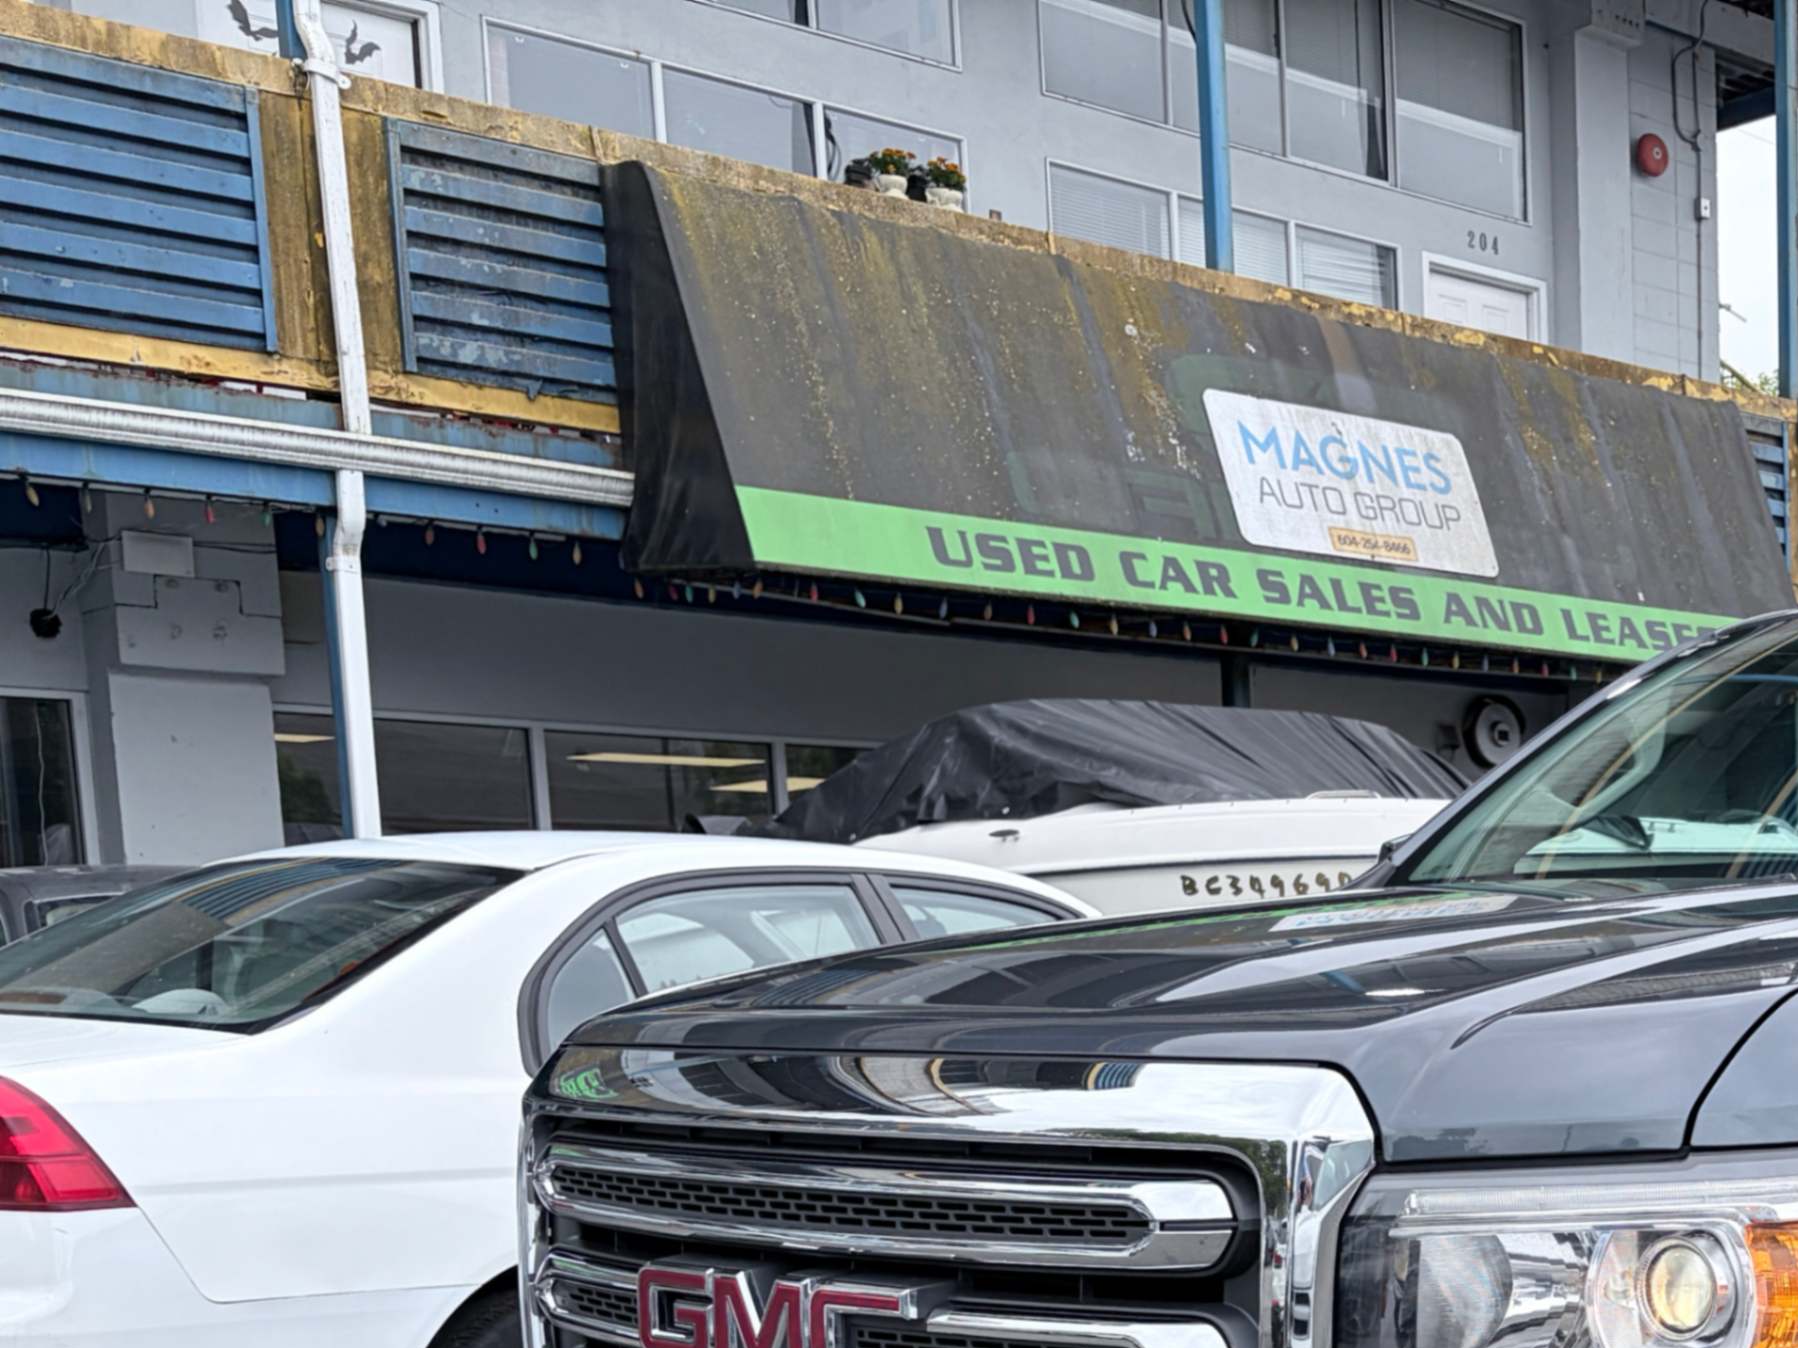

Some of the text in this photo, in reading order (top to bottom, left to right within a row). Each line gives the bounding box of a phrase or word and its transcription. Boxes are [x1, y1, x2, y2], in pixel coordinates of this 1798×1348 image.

[1467, 230, 1499, 255] 204
[1237, 420, 1452, 495] MAGNES
[1259, 477, 1347, 515] AUTO
[1353, 491, 1461, 531] GROUP
[926, 526, 1718, 651] USED CAR SALES AND LEASE
